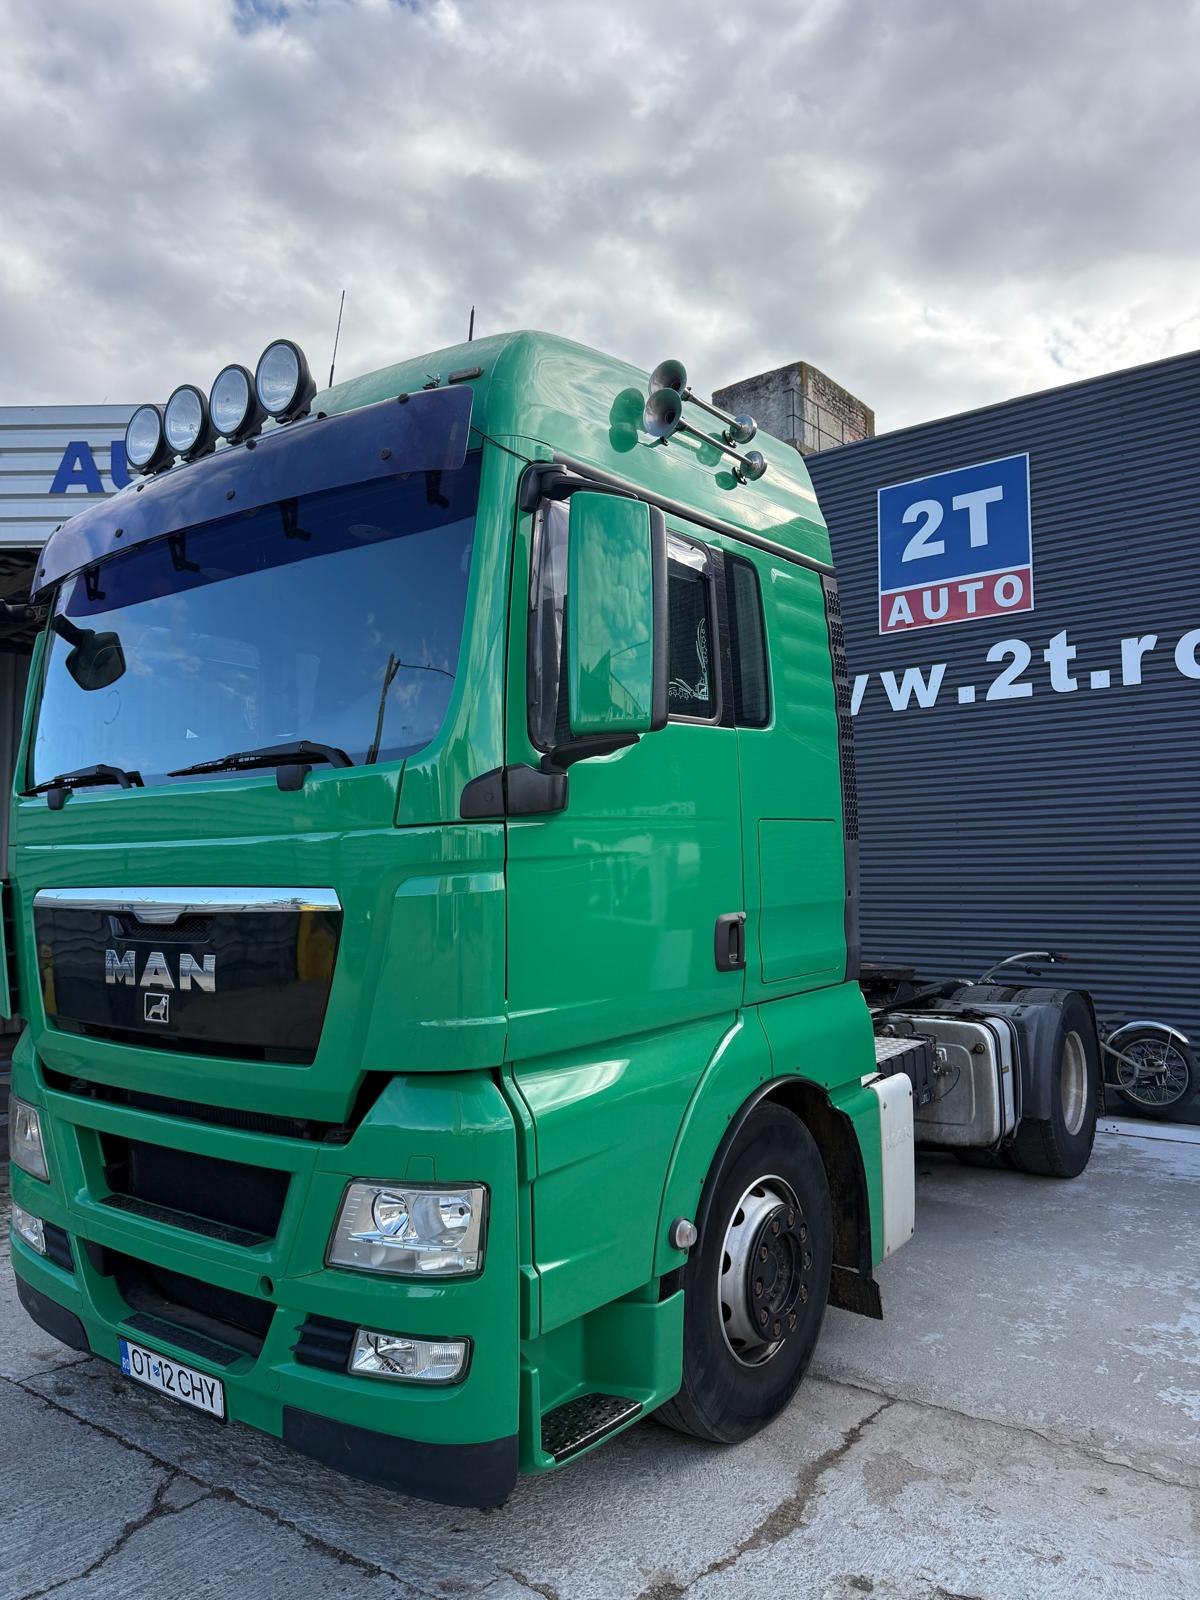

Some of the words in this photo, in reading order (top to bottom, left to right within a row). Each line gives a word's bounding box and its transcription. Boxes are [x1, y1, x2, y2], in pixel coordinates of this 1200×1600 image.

[901, 485, 1003, 563] 2T
[887, 574, 1024, 627] AUTO
[105, 949, 216, 992] MAN
[131, 1348, 152, 1380] OT
[158, 1360, 176, 1392] 12
[177, 1369, 216, 1408] CHY
